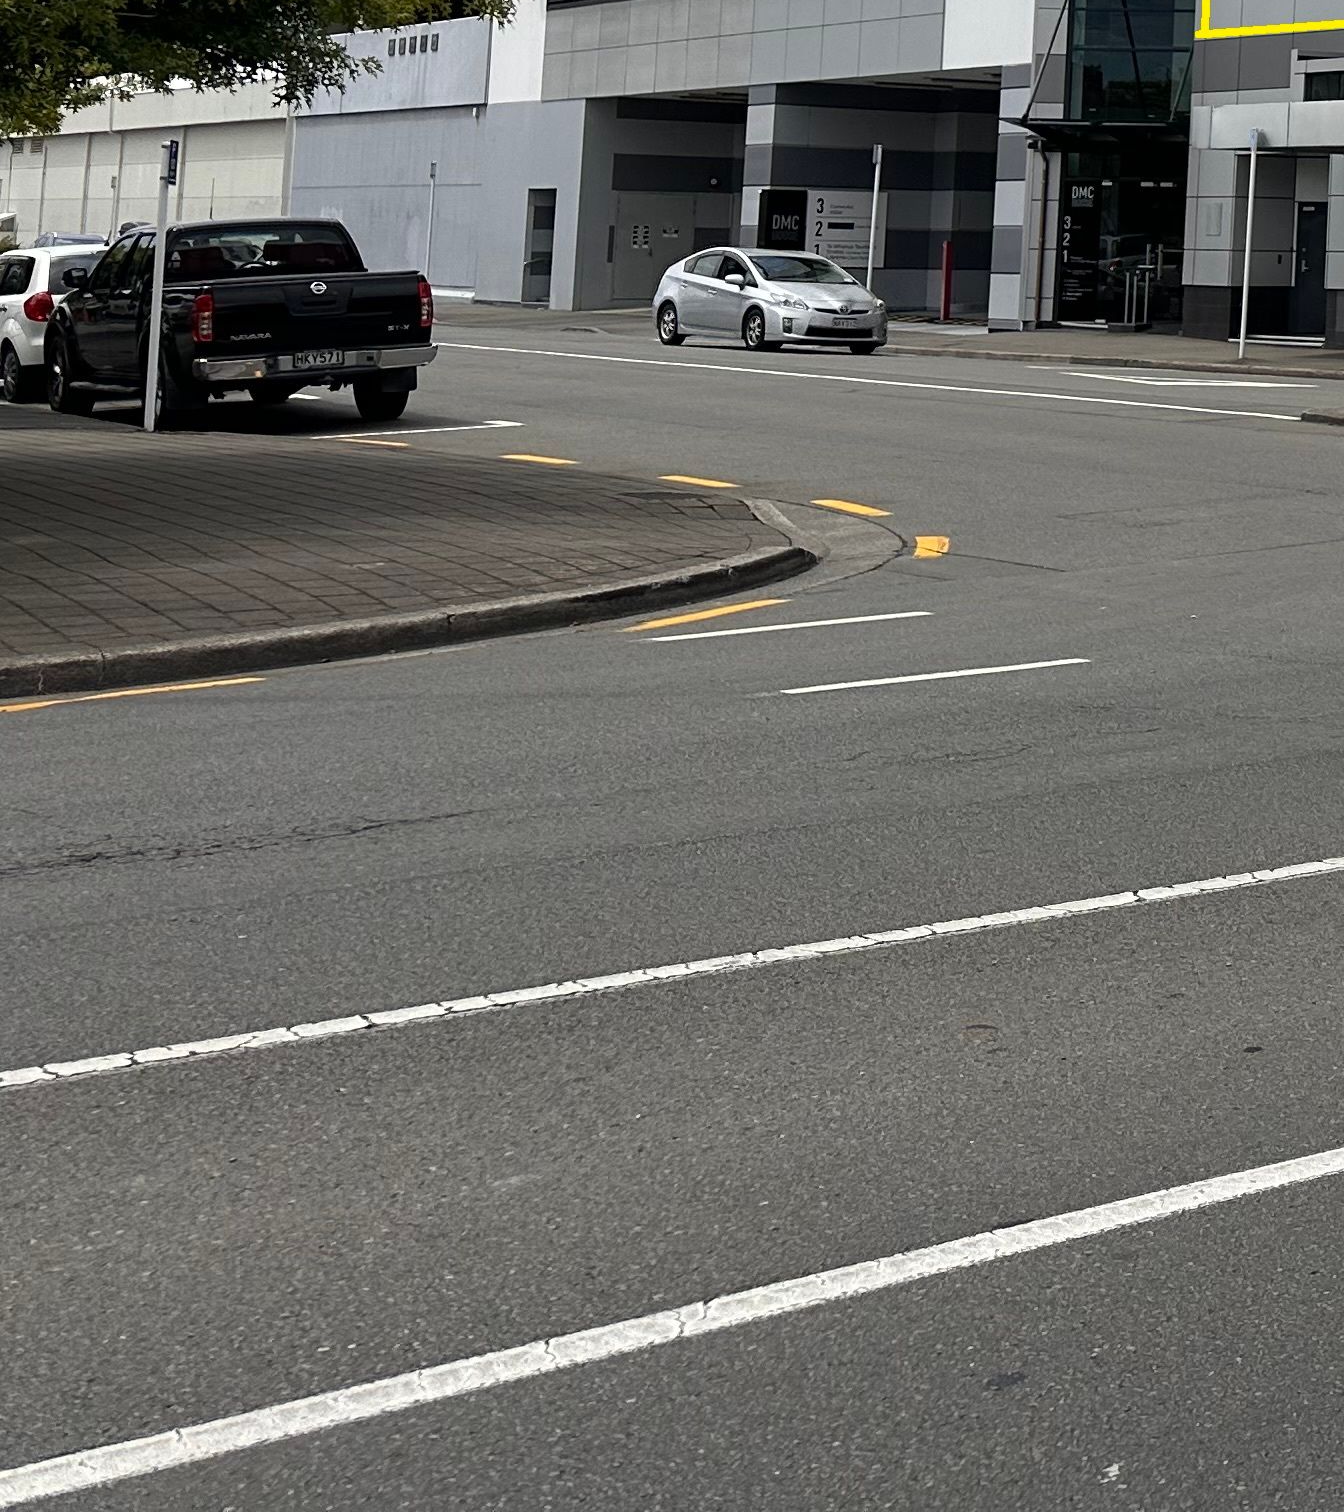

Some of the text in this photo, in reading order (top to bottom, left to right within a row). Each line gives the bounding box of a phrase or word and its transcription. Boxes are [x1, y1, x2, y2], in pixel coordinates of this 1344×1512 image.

[1072, 186, 1094, 199] DMC
[817, 197, 825, 214] 3
[772, 214, 800, 230] DMC
[815, 221, 823, 236] 2
[1063, 215, 1072, 229] 3
[1062, 233, 1071, 246] 2
[1062, 250, 1068, 262] 1
[295, 350, 342, 367] HKY571
